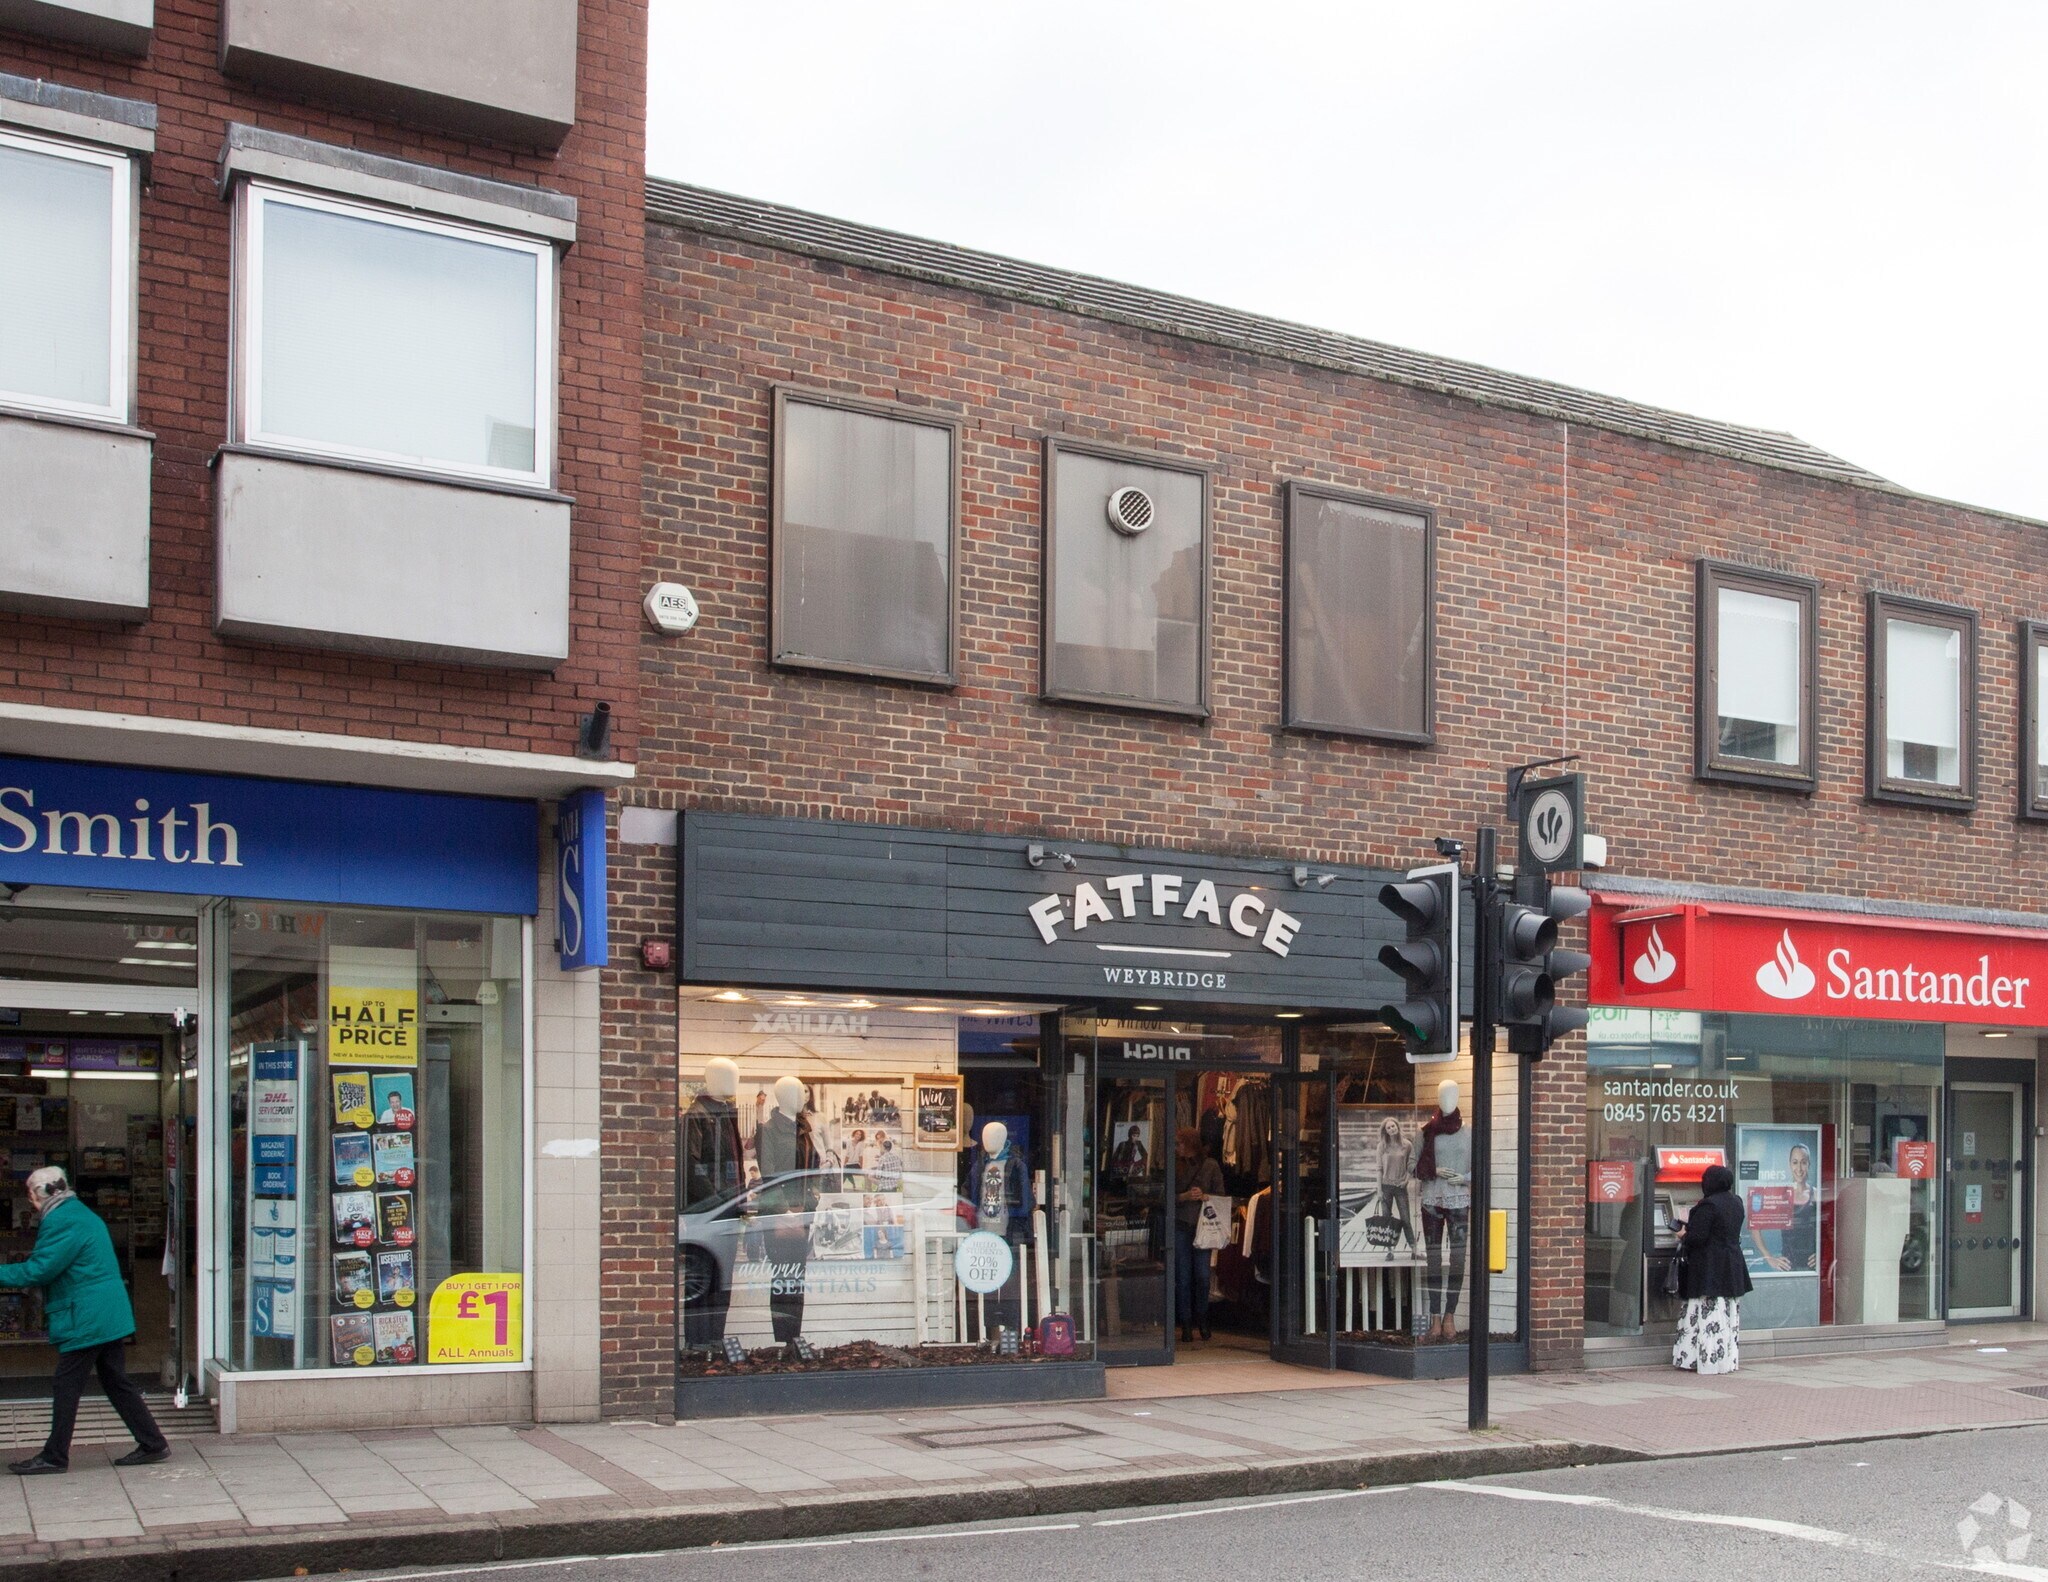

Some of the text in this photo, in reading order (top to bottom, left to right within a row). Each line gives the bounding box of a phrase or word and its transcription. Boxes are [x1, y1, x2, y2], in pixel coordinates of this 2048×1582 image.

[661, 596, 686, 609] AES
[0, 787, 243, 867] Smith
[562, 844, 582, 956] S
[1028, 874, 1302, 958] FATFACE
[1103, 967, 1227, 989] WEYBRIDGE
[1826, 948, 2030, 1009] Santander
[332, 1006, 415, 1029] HALF
[340, 1028, 407, 1046] PRICE
[1604, 1077, 1739, 1099] santander.co.uk
[264, 1093, 287, 1103] DHL
[920, 1089, 946, 1106] Win
[1603, 1103, 1725, 1123] 0845 765 4321
[1680, 1155, 1716, 1165] Santander
[966, 1248, 1004, 1256] STUDENTS
[804, 1264, 888, 1275] WARDROBE
[969, 1255, 998, 1267] 20%
[969, 1269, 998, 1281] OFF
[501, 1282, 521, 1290] FOR
[457, 1290, 508, 1345] £1
[437, 1348, 514, 1358] ALL Annuals
